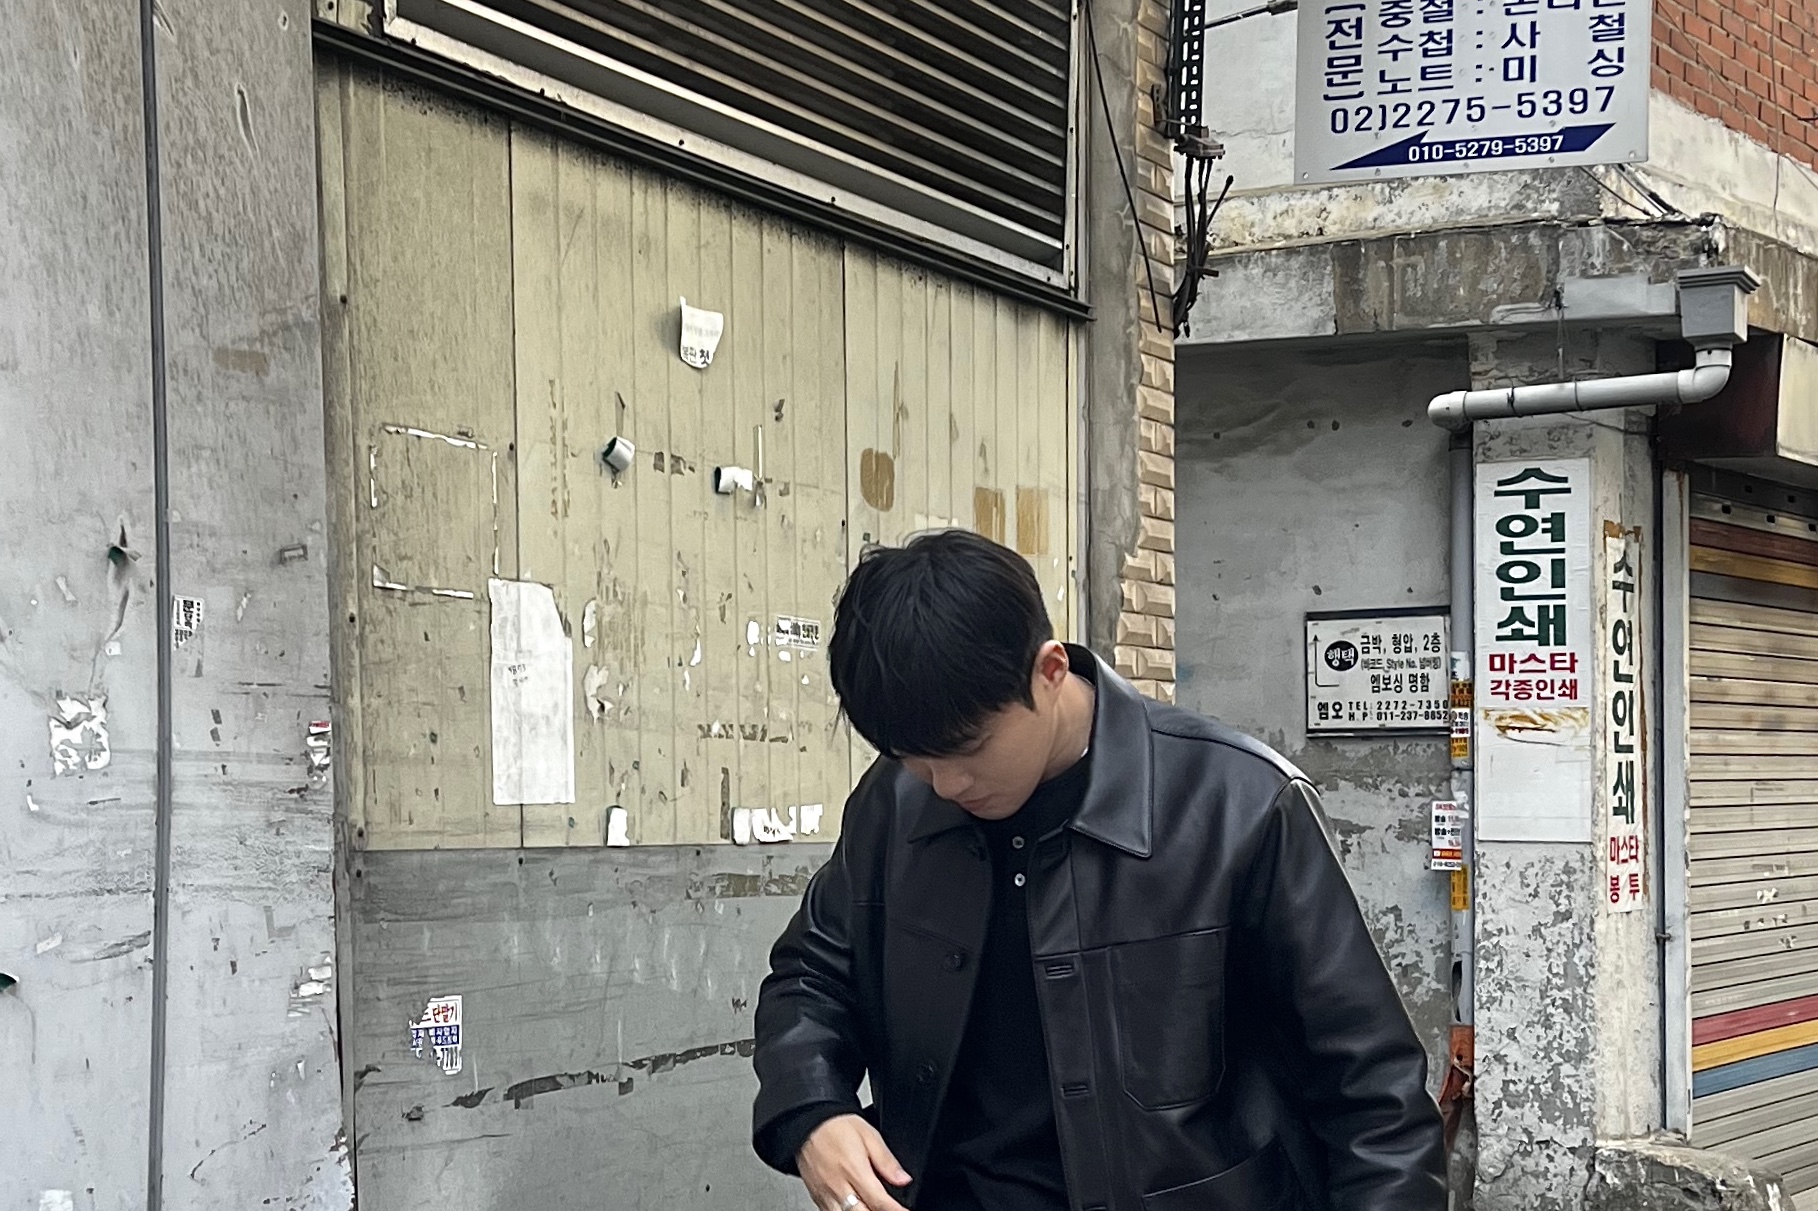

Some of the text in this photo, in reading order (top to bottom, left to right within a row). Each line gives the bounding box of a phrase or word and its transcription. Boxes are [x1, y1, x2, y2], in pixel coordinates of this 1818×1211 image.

[1378, 28, 1454, 62] 수첩
[1377, 63, 1454, 95] 노트
[1331, 86, 1615, 134] 02)2275-5397
[1408, 135, 1564, 162] 010-5279-5397
[1494, 467, 1572, 647] 수연인쇄
[1423, 632, 1441, 653] 2층
[1489, 652, 1579, 674] 마스타
[1370, 673, 1430, 694] 엠보싱 명함
[1490, 679, 1578, 701] 각종인쇄
[1611, 550, 1635, 825] 수연인쇄
[1609, 835, 1640, 864] 마스타
